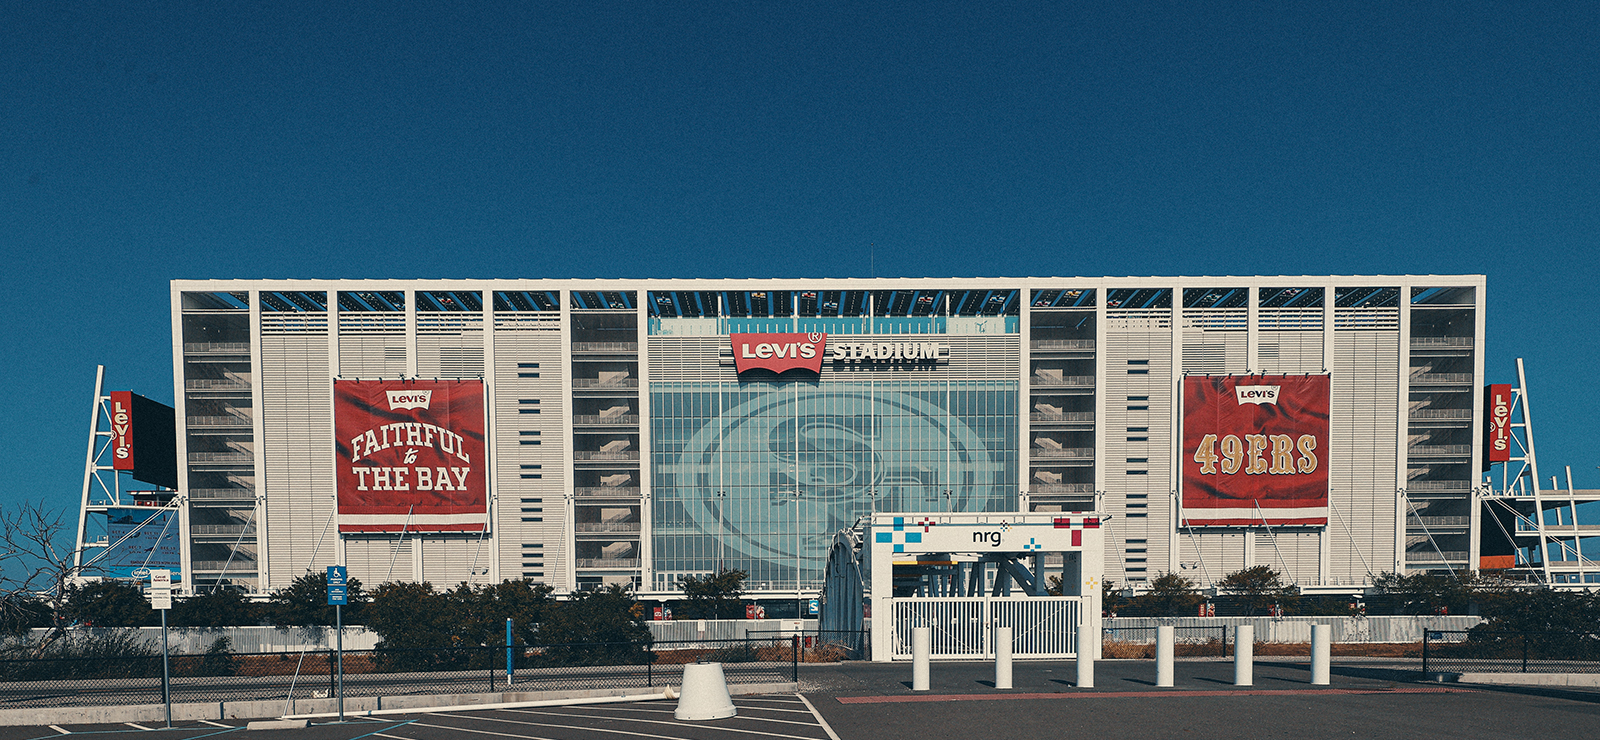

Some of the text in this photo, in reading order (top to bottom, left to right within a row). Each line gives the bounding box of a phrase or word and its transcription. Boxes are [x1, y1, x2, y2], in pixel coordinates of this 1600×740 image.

[833, 342, 940, 361] STADIUM
[351, 422, 471, 464] FAITHFUL
[403, 447, 419, 464] to
[1193, 434, 1318, 475] 49ERS
[352, 466, 471, 491] THE BAY
[973, 531, 1001, 547] nrg
